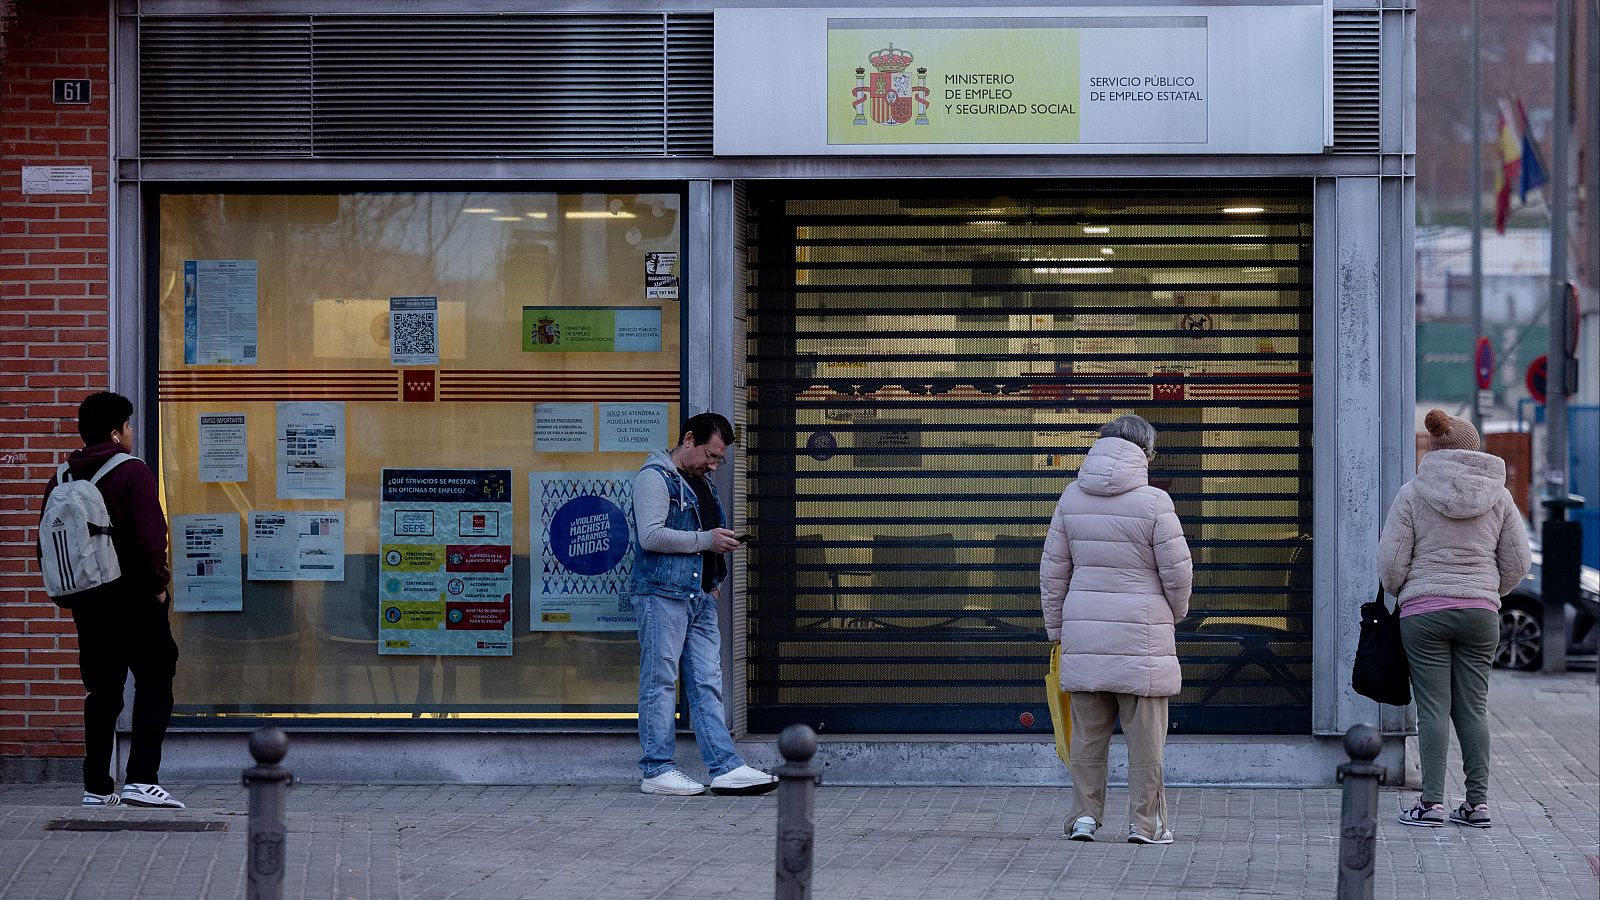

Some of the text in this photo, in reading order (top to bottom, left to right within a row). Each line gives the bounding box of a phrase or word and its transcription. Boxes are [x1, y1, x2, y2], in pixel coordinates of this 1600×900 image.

[944, 74, 1015, 85] MINISTERIO
[1089, 74, 1195, 87] SERVICIO PÚBLICO
[64, 82, 81, 101] 61
[944, 89, 1013, 100] DE EMPLEO
[1089, 91, 1203, 101] DE EMPLEO ESTATAL
[944, 104, 1076, 115] Y SEGURIDAD SOCIAL
[575, 513, 609, 526] VIOLENCIA
[402, 524, 426, 533] SEPE
[569, 521, 611, 537] MACHISTA
[577, 530, 608, 543] PARAMOS
[568, 538, 610, 558] UNIDAS
